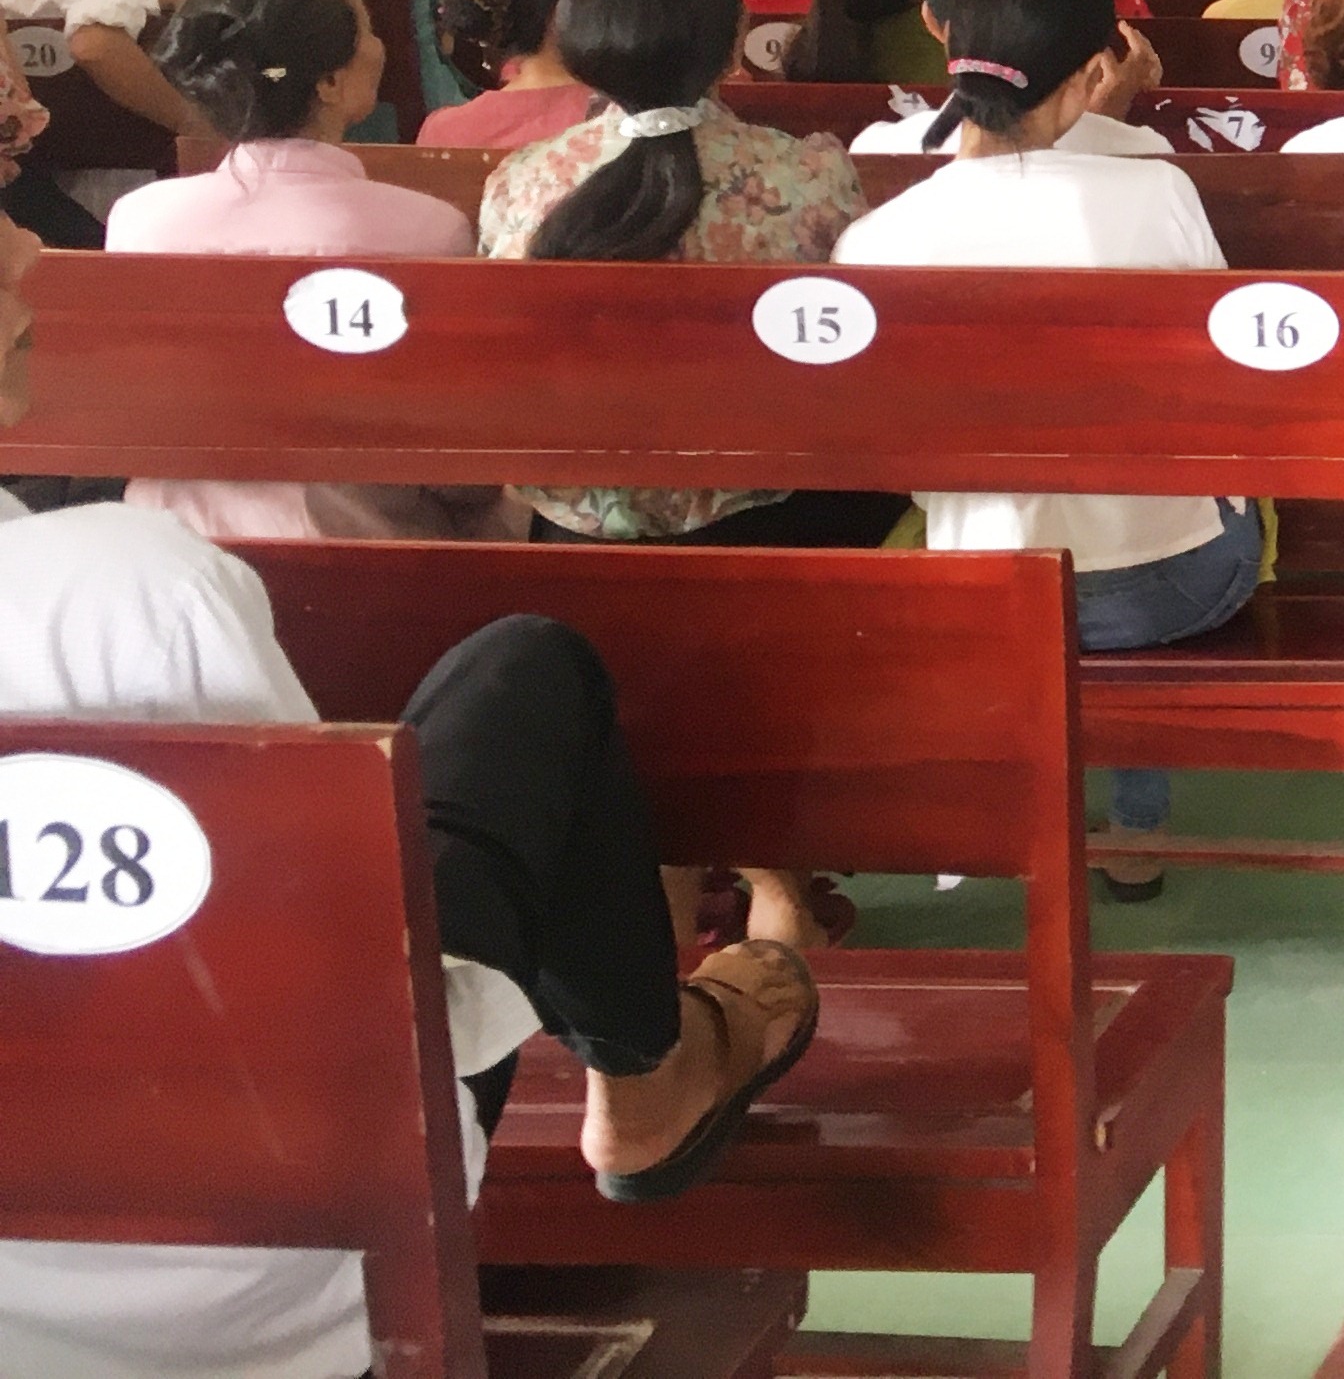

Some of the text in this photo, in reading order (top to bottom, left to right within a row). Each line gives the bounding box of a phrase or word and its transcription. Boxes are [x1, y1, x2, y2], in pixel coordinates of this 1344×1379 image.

[21, 43, 56, 67] 20
[324, 297, 374, 340] 14
[791, 306, 842, 345] 15
[1251, 311, 1300, 350] 16
[0, 819, 154, 907] 128
